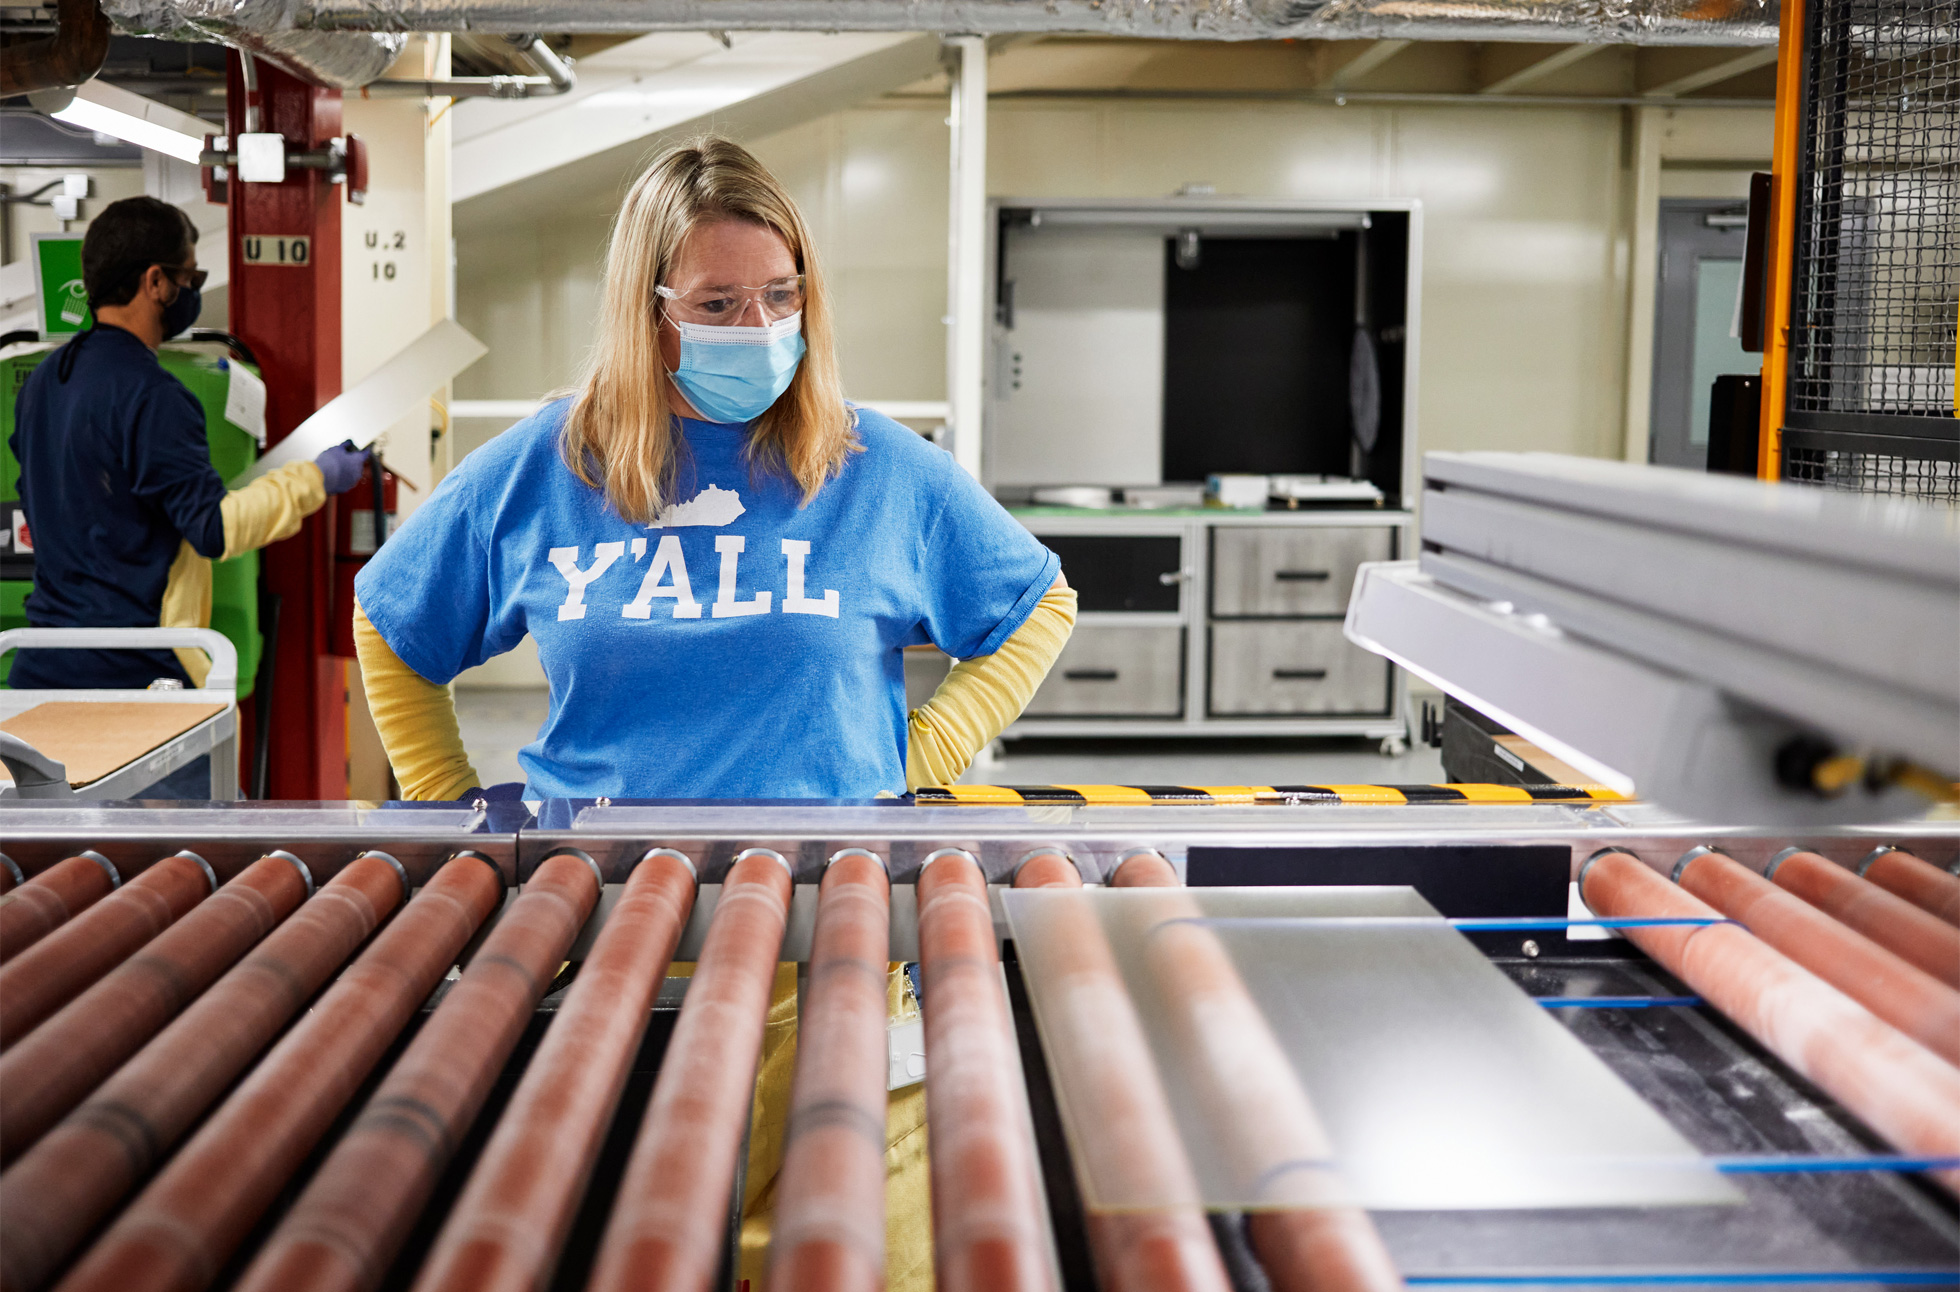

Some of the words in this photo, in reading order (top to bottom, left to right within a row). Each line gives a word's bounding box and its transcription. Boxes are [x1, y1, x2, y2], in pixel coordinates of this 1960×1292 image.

[364, 231, 405, 249] U.2
[246, 239, 261, 260] U
[278, 239, 307, 262] 10
[373, 263, 396, 280] 10
[548, 535, 839, 621] Y'ALL
